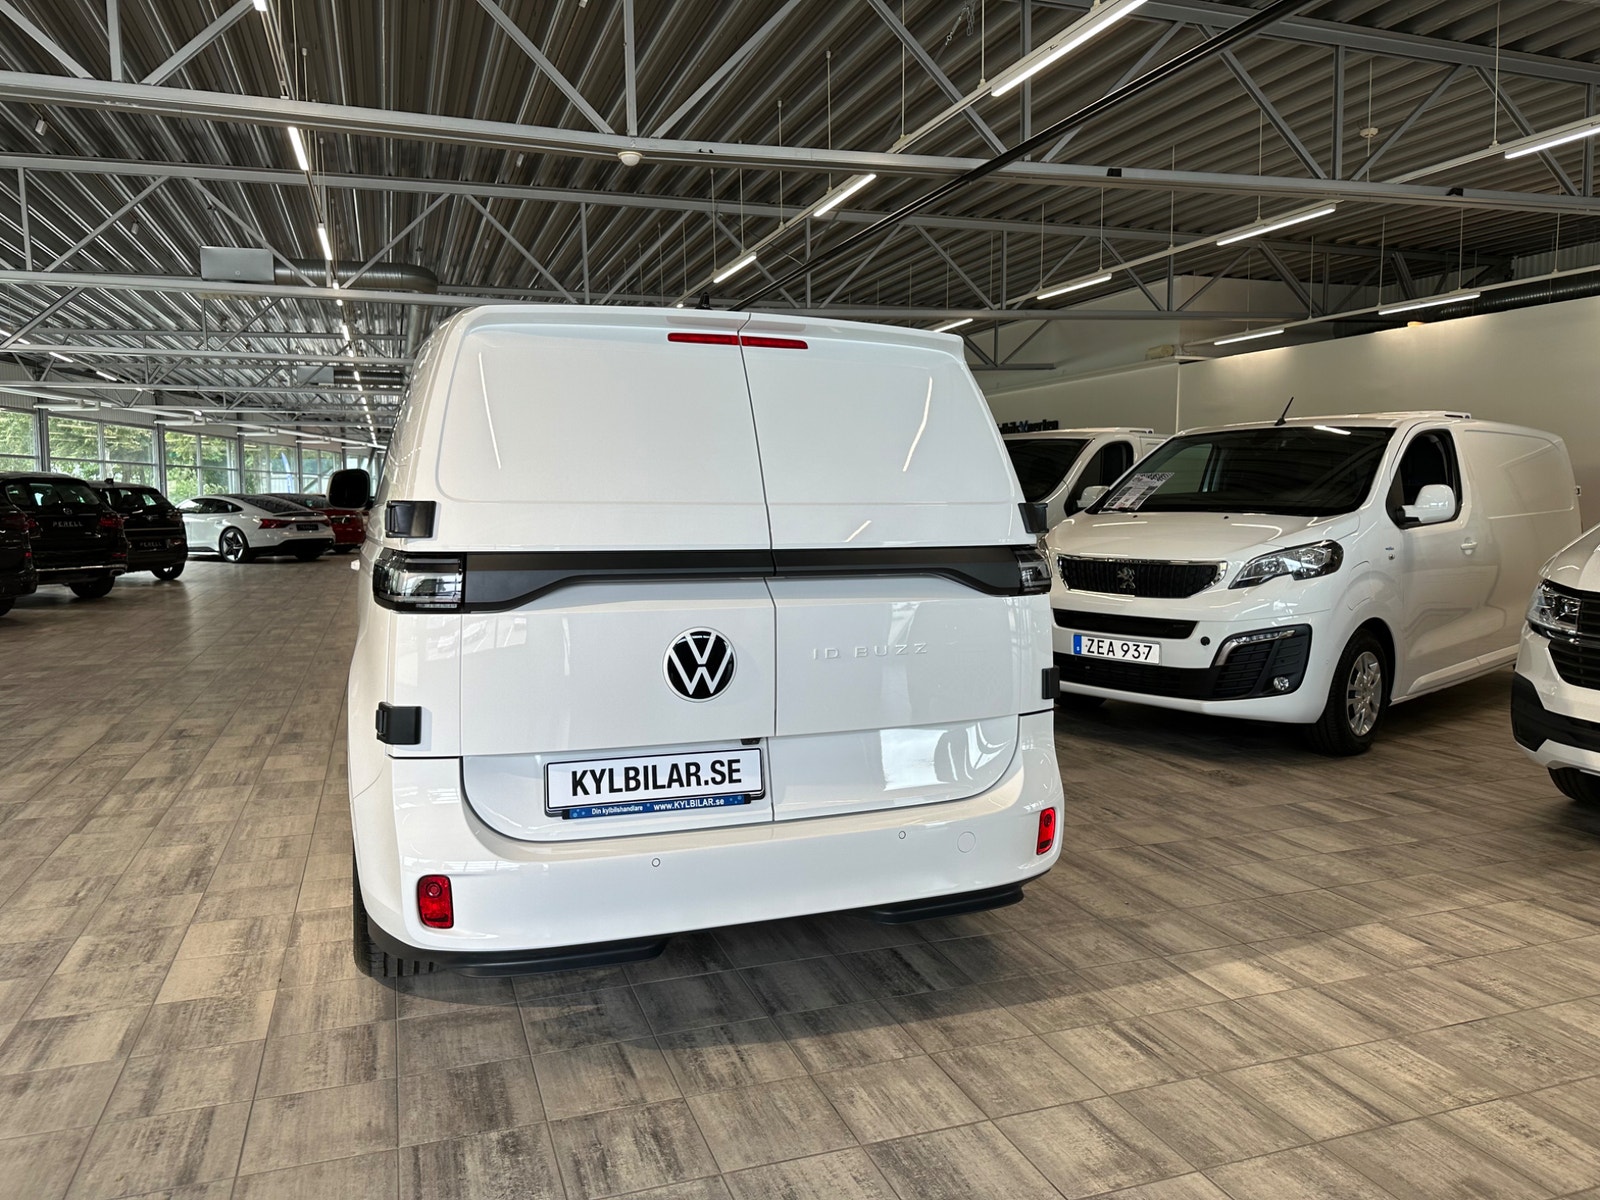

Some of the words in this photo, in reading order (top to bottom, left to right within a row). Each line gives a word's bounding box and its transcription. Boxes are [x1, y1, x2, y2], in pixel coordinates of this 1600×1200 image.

[855, 643, 928, 658] BUZZ
[1086, 638, 1116, 657] ZEA
[1120, 642, 1153, 661] 937
[571, 758, 742, 797] KYLBILAR.SE
[591, 807, 602, 815] Din
[602, 805, 643, 815] kylbilshandlare
[653, 798, 725, 811] www.KYLBILAR.se
